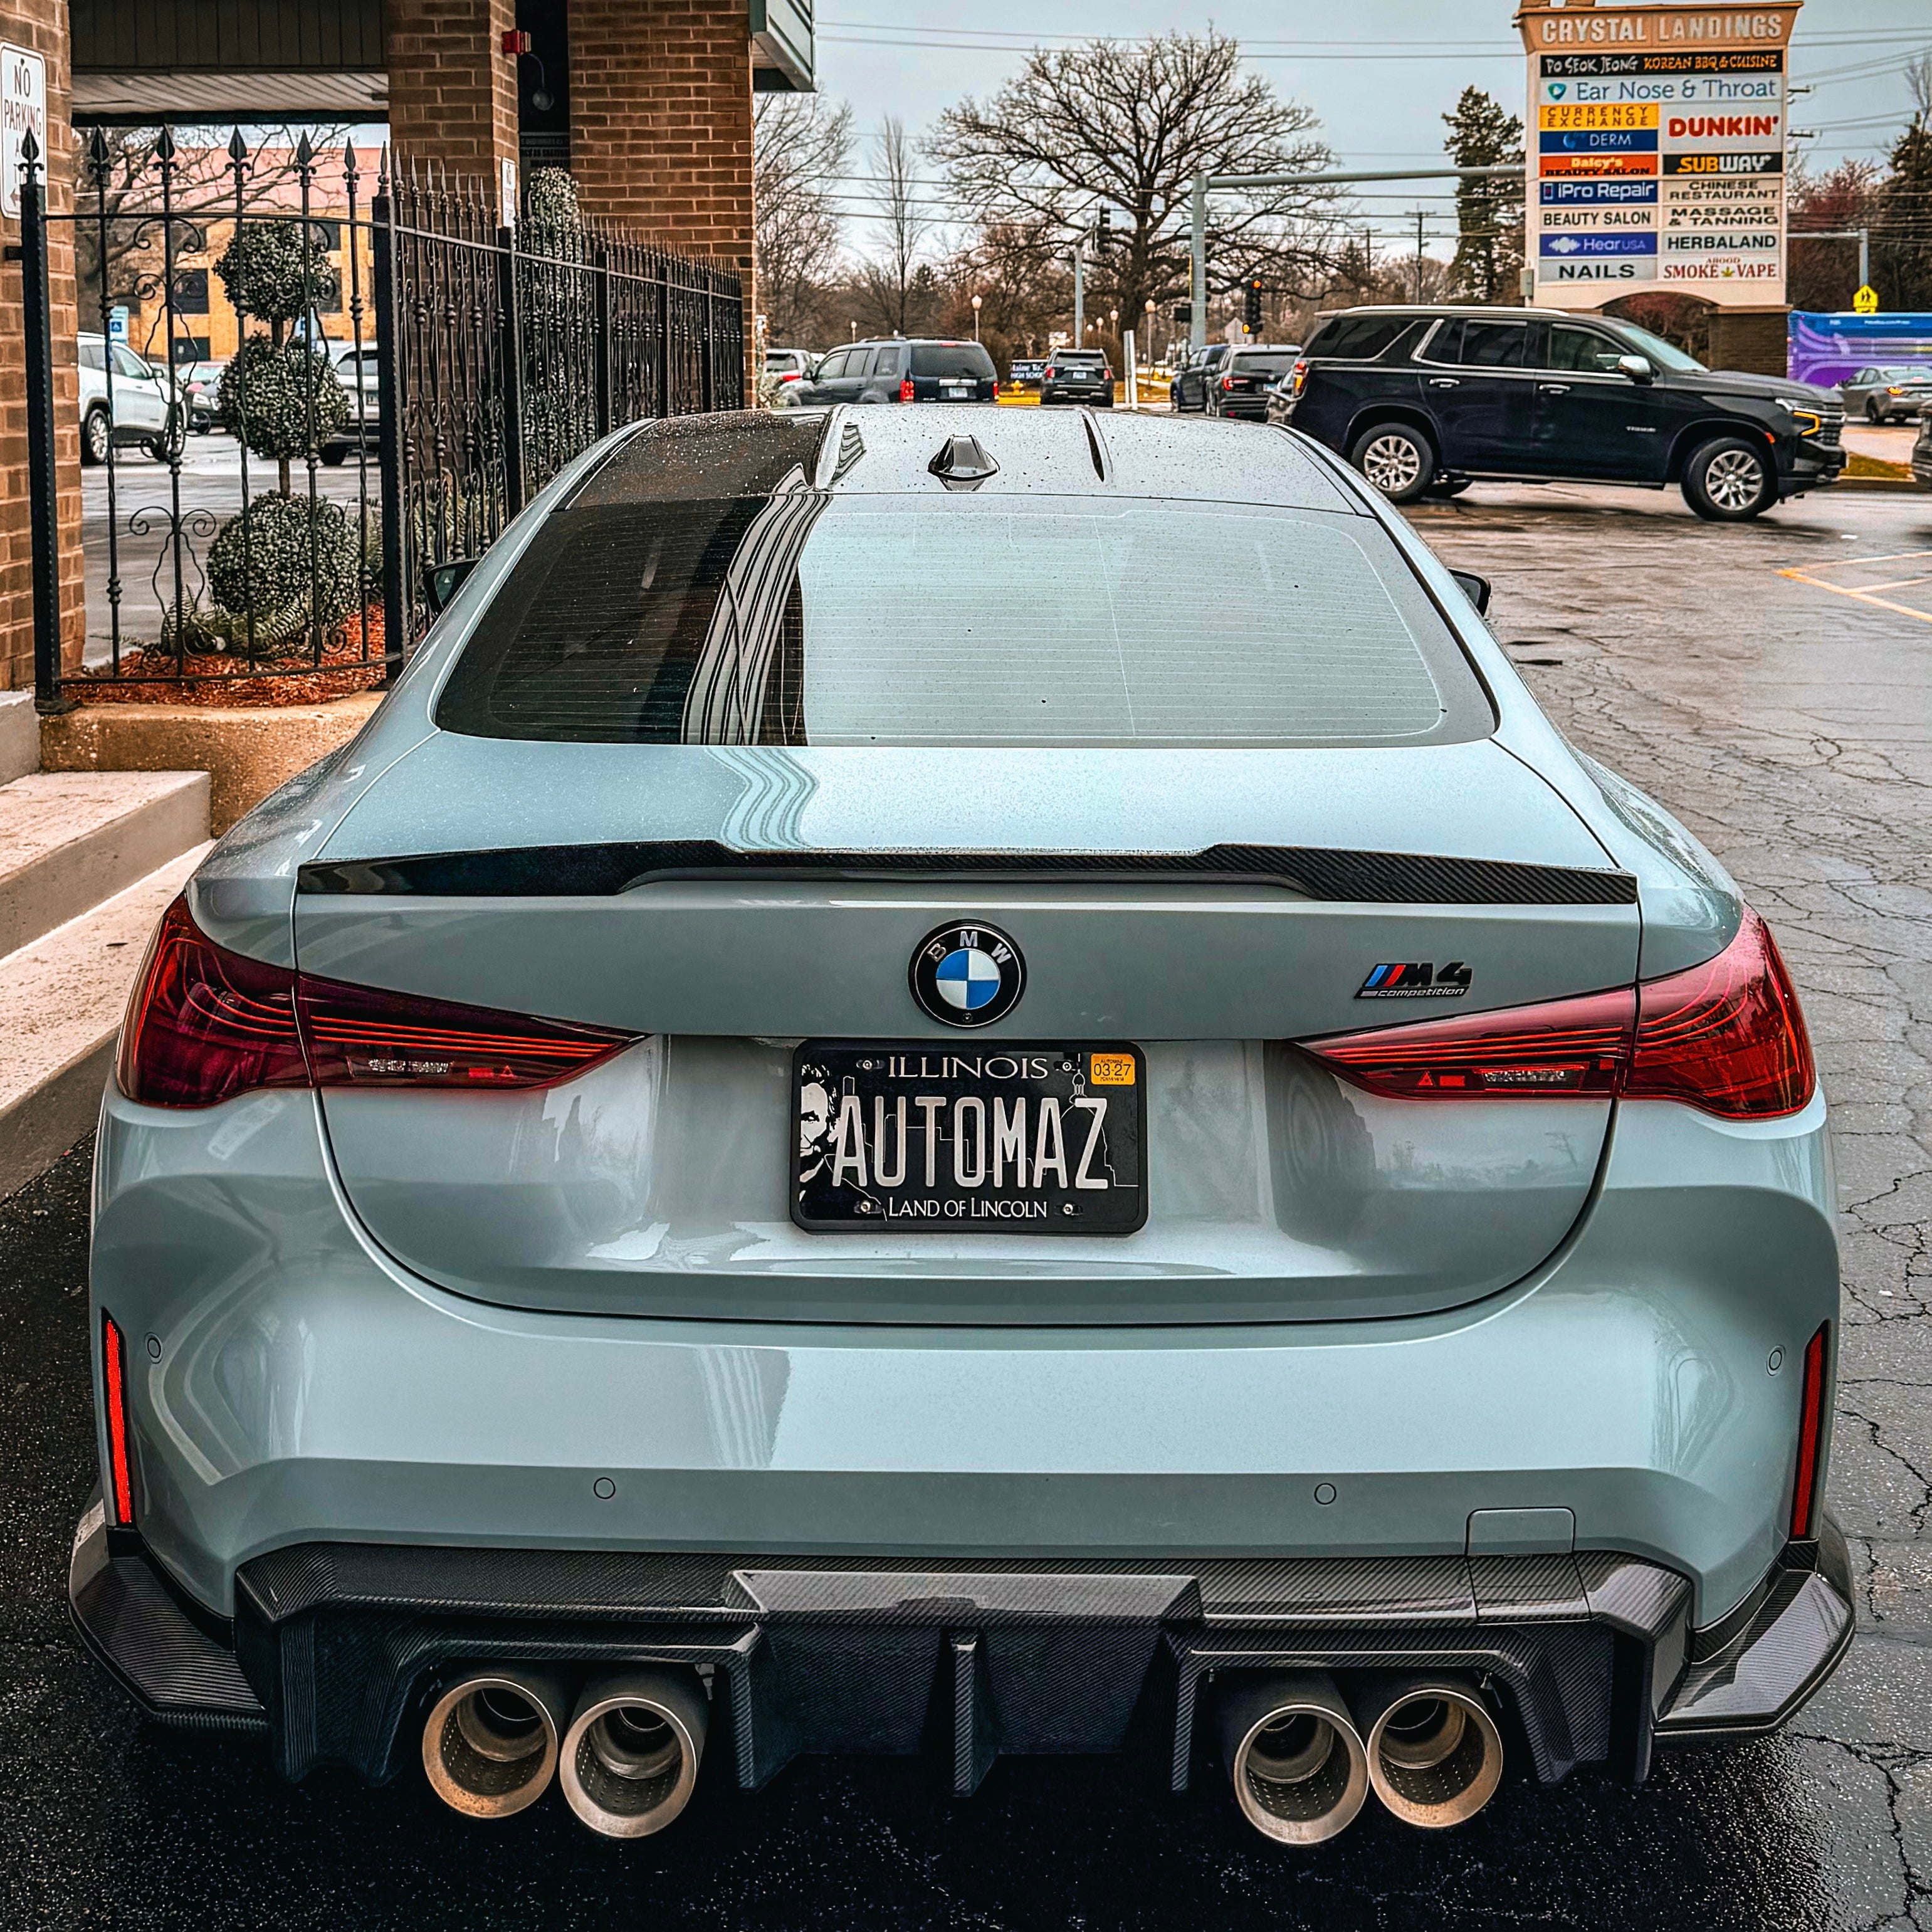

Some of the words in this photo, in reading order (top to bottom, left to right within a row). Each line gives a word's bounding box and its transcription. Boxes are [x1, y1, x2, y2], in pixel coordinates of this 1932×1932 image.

[1542, 16, 1647, 44] CRYSTAL
[1659, 13, 1782, 41] LANDINGS
[1546, 58, 1563, 74] PO
[1565, 56, 1598, 74] SEOK
[1600, 56, 1638, 74] JEONG
[1643, 56, 1692, 70] KOREAN
[1694, 56, 1718, 71] BBQ
[1719, 56, 1728, 68] &
[1730, 55, 1777, 68] CUISINE
[14, 65, 31, 97] NO
[1577, 81, 1610, 100] Ear
[1619, 81, 1674, 100] Nose
[1682, 79, 1696, 98] &
[1703, 79, 1776, 98] Throat
[4, 98, 41, 136] PARKING
[1548, 106, 1649, 117] CURRENCY
[1548, 117, 1649, 128] EXCHANGE
[1669, 115, 1779, 137] DUNKIN'
[1589, 133, 1632, 147] DERM
[1676, 154, 1768, 173] SUBWAY
[1597, 181, 1655, 201] Repair
[1688, 179, 1759, 191] CHINESE
[1669, 189, 1778, 201] RESTAURANT
[1543, 213, 1599, 226] BEAUTY
[1604, 211, 1651, 225] SALON
[1671, 207, 1776, 217] MASSAGE
[1668, 218, 1681, 226] &
[1688, 216, 1779, 226] TANNING
[1667, 235, 1777, 249] HERBALAND
[1558, 264, 1635, 279] NAILS
[1663, 264, 1719, 279] SMOKE
[1736, 263, 1777, 278] VAPE
[927, 930, 1012, 964] BMW
[1378, 987, 1466, 997] competition
[888, 1056, 1049, 1079] ILLINOIS
[1094, 1063, 1131, 1076] 03-27
[832, 1096, 1109, 1189] AUTOMAZ
[944, 1200, 967, 1217] OF
